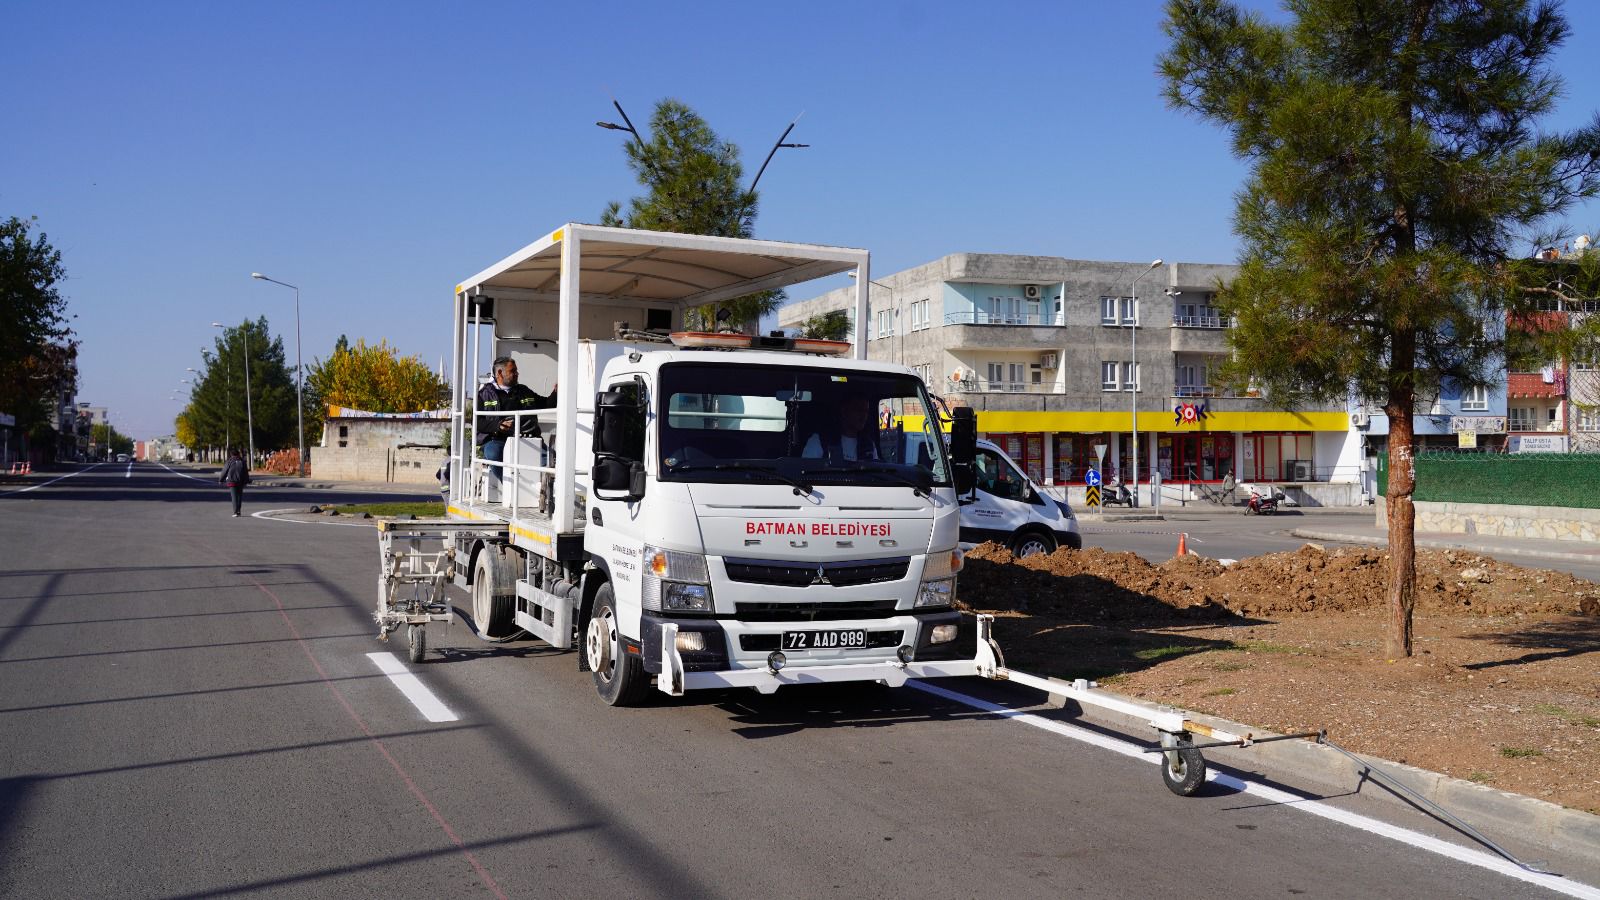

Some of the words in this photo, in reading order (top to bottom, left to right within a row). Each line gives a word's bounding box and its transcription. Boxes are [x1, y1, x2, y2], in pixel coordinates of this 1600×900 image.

[1175, 403, 1208, 427] ŞOK
[746, 522, 806, 536] BATMAN
[811, 521, 891, 537] BELEDİYESİ
[789, 632, 806, 648] 72
[813, 632, 837, 647] AAD
[840, 631, 864, 646] 989
